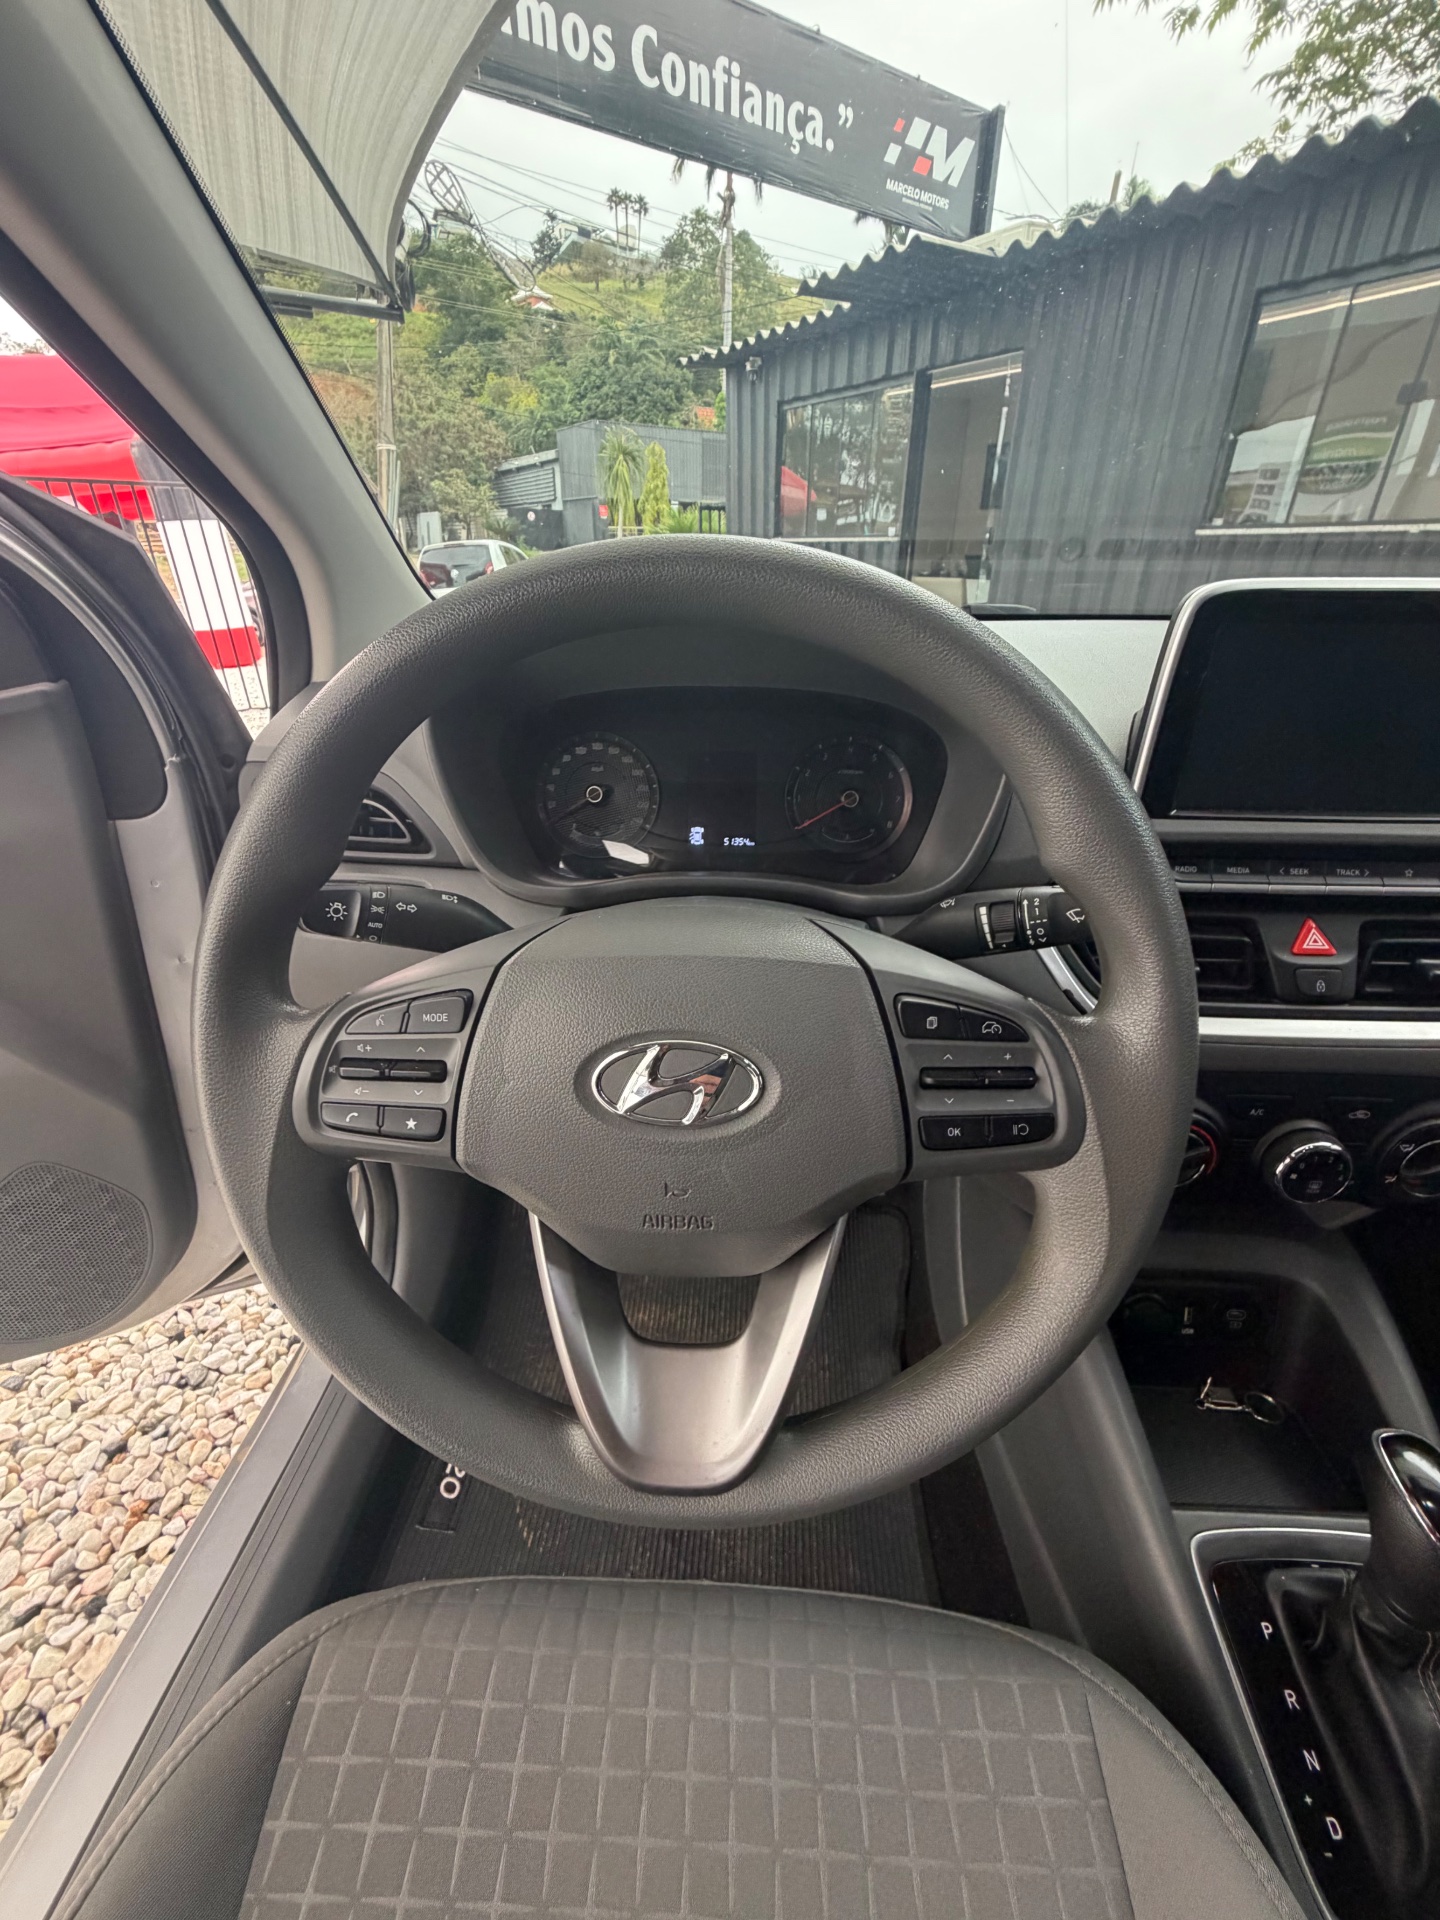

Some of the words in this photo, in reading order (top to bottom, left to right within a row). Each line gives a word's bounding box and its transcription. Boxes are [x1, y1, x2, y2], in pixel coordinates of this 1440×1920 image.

[885, 177, 921, 200] MARCELO
[920, 189, 950, 210] MOTORS
[1174, 865, 1198, 873] RADIO
[1226, 866, 1250, 874] MEDIA
[1289, 867, 1309, 875] SEEK
[1336, 868, 1361, 876] TRACK
[1033, 897, 1040, 906] 2
[368, 921, 383, 929] AUTO
[422, 1013, 449, 1022] MODE
[947, 1127, 962, 1137] OK
[642, 1213, 714, 1230] AIRBAG
[1260, 1621, 1273, 1640] P
[1284, 1689, 1300, 1711] R
[1302, 1750, 1321, 1772] N
[1325, 1816, 1343, 1841] D
